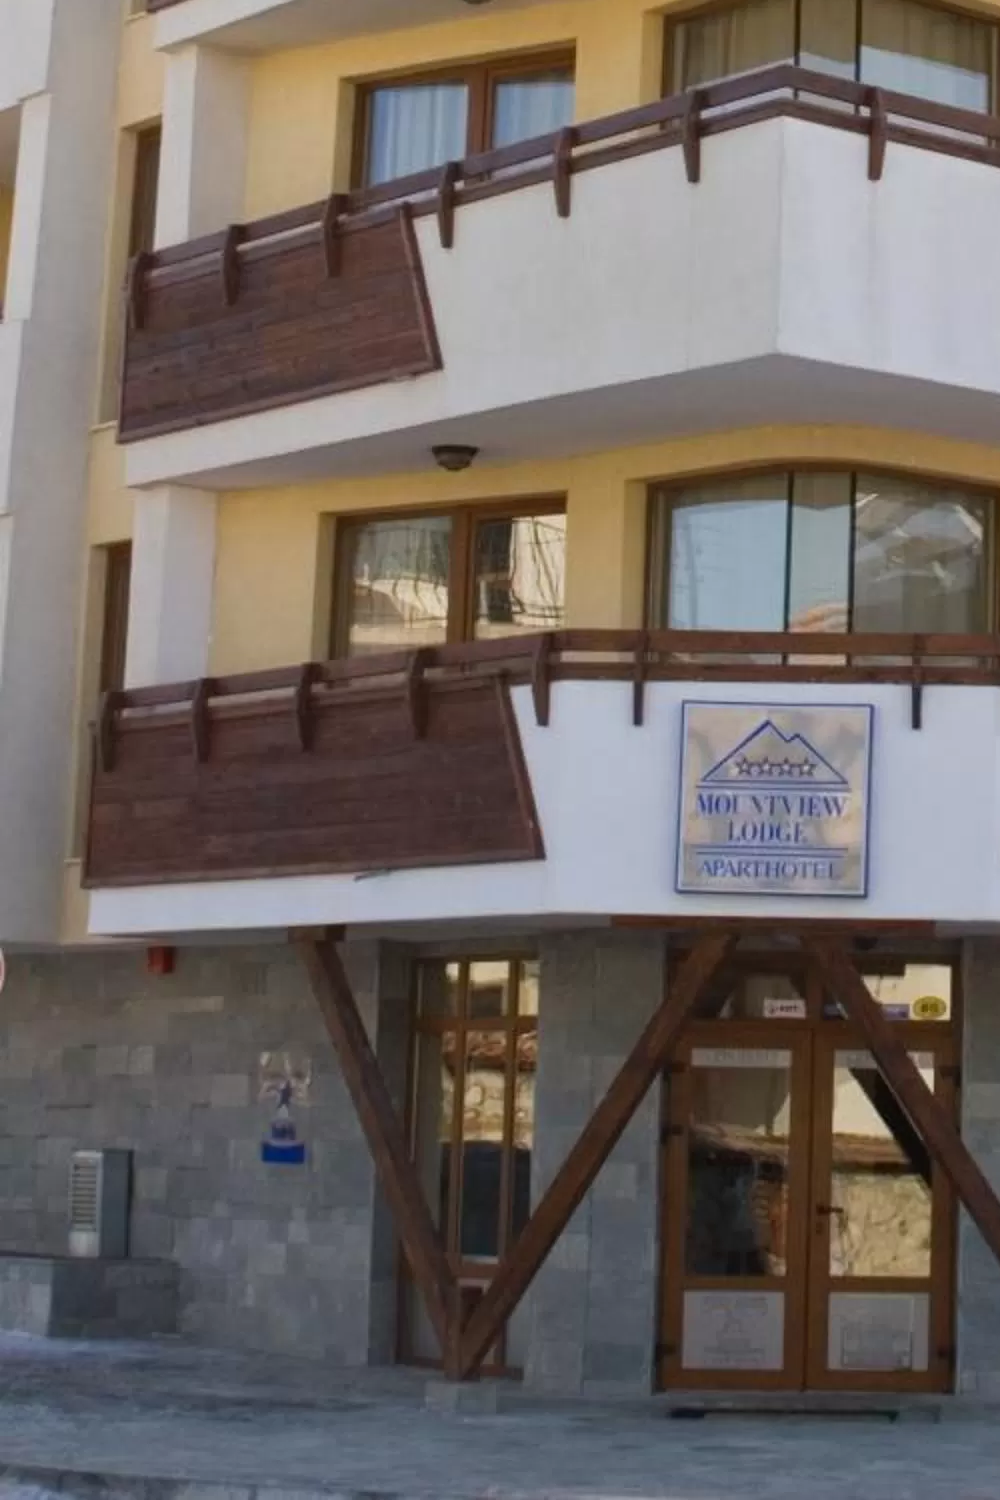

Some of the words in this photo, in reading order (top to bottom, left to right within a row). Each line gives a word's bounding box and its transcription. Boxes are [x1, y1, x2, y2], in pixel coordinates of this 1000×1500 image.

[696, 792, 848, 818] MOUNTVIEW
[727, 819, 809, 844] LODGE
[696, 859, 842, 881] APARTHOTEL
